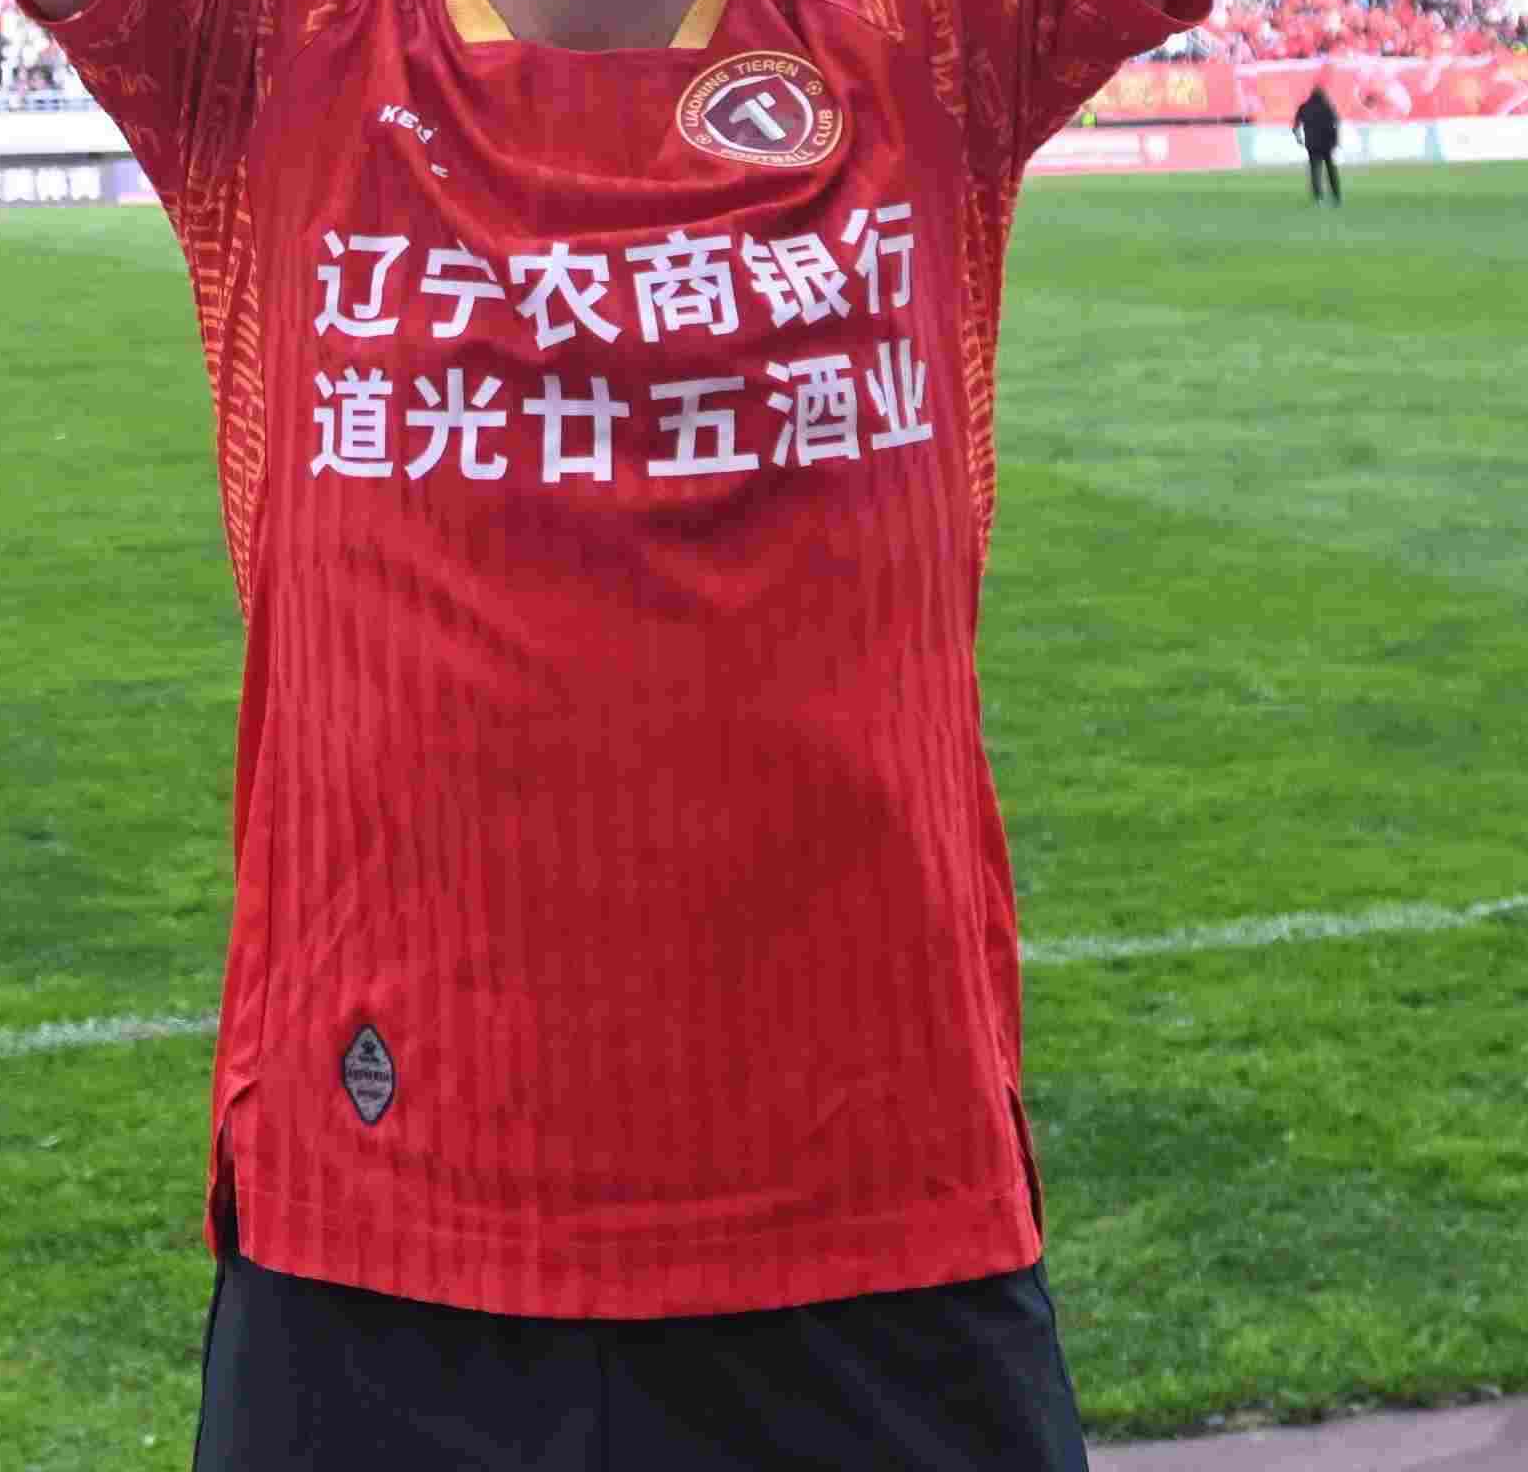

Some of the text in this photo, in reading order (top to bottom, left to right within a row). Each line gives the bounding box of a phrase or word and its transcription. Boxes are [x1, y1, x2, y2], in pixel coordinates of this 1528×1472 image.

[734, 59, 800, 77] TIEREN
[812, 108, 834, 146] CLUB
[313, 201, 915, 351] 辽宁农商银行
[309, 338, 934, 484] 道光廿五酒业
